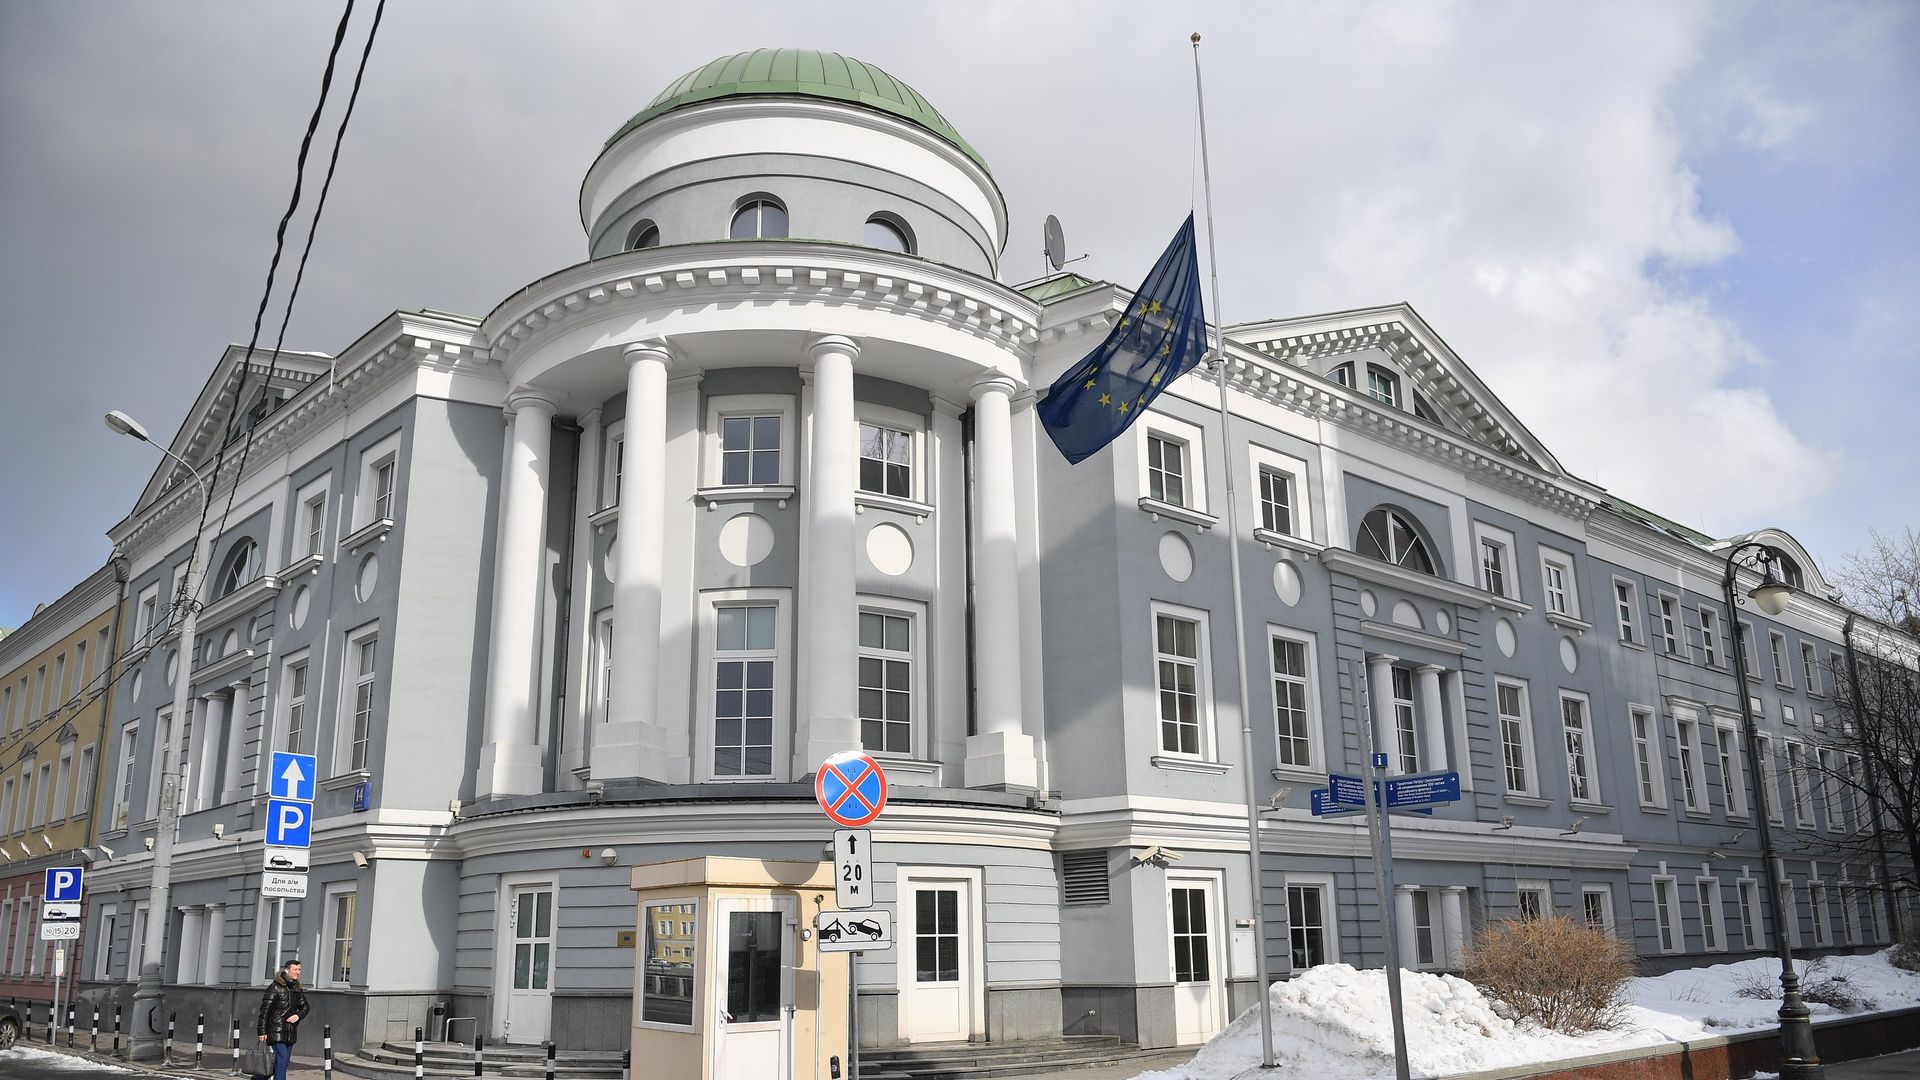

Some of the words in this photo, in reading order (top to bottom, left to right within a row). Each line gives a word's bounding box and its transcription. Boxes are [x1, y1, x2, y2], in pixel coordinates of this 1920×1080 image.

[278, 805, 304, 841] P
[272, 877, 286, 885] Для
[843, 864, 862, 881] 20
[54, 871, 74, 898] P
